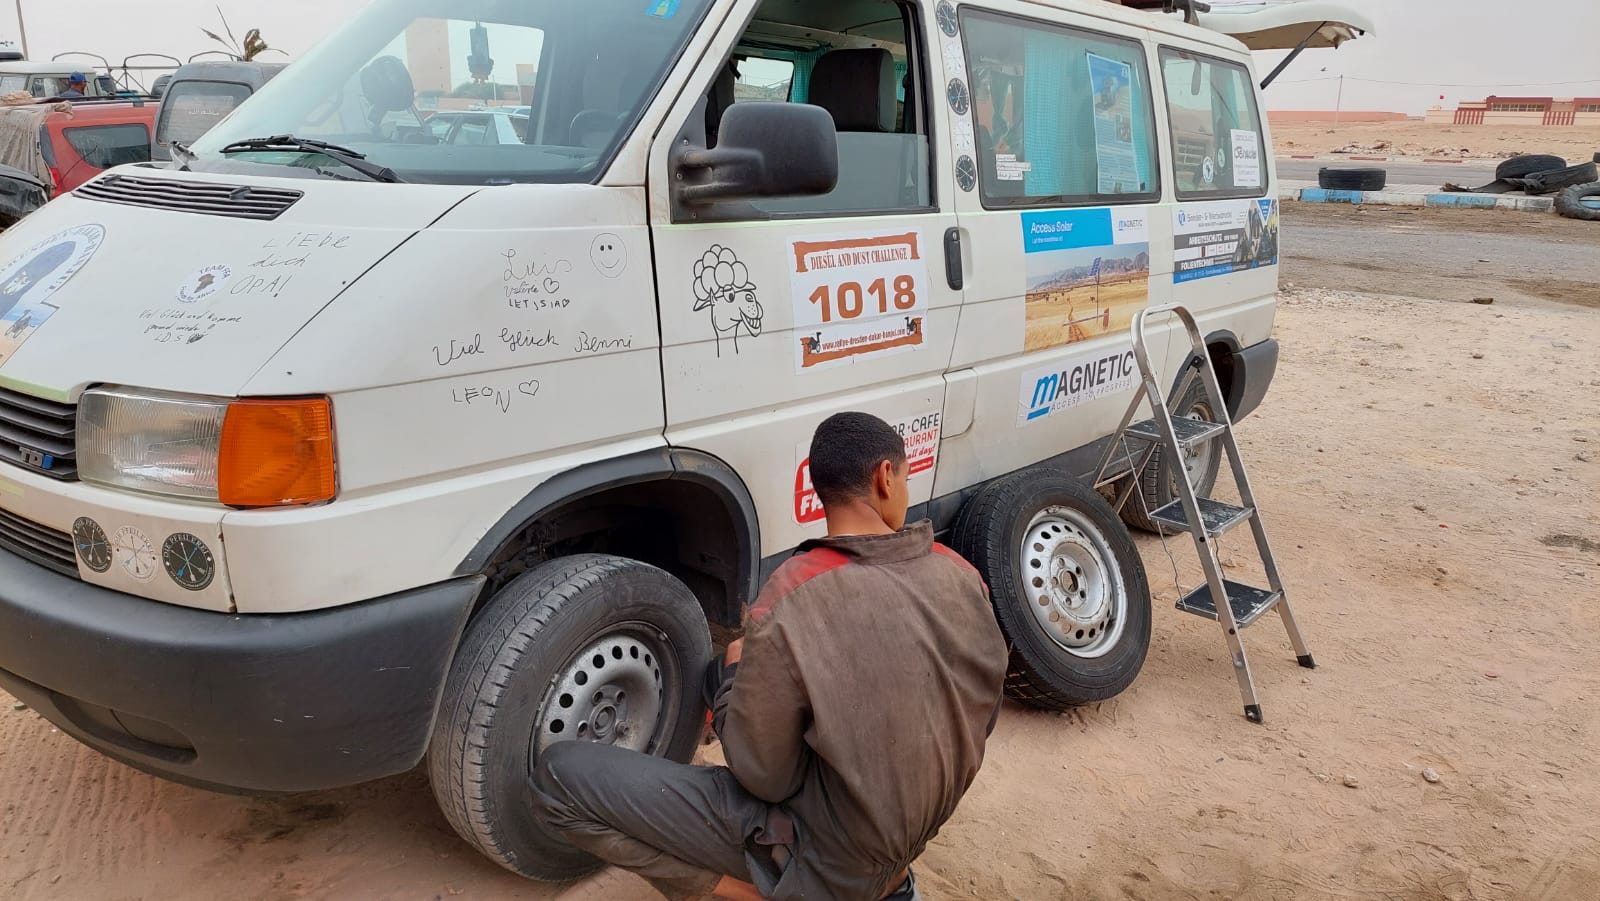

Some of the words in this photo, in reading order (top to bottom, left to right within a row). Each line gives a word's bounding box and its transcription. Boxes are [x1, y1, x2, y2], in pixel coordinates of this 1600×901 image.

[1030, 222, 1055, 234] Access
[1056, 221, 1073, 232] Solar
[810, 253, 837, 271] DIESEL
[838, 252, 851, 267] AND
[853, 250, 870, 266] DUST
[871, 248, 908, 263] CHALLENGE
[231, 275, 293, 298] OPA!
[809, 274, 916, 323] 1018
[432, 334, 485, 366] Viel
[499, 328, 560, 351] Glück
[575, 332, 633, 353] Benni
[452, 386, 511, 413] LEON
[911, 413, 940, 433] CAFE
[904, 428, 938, 449] AURANT
